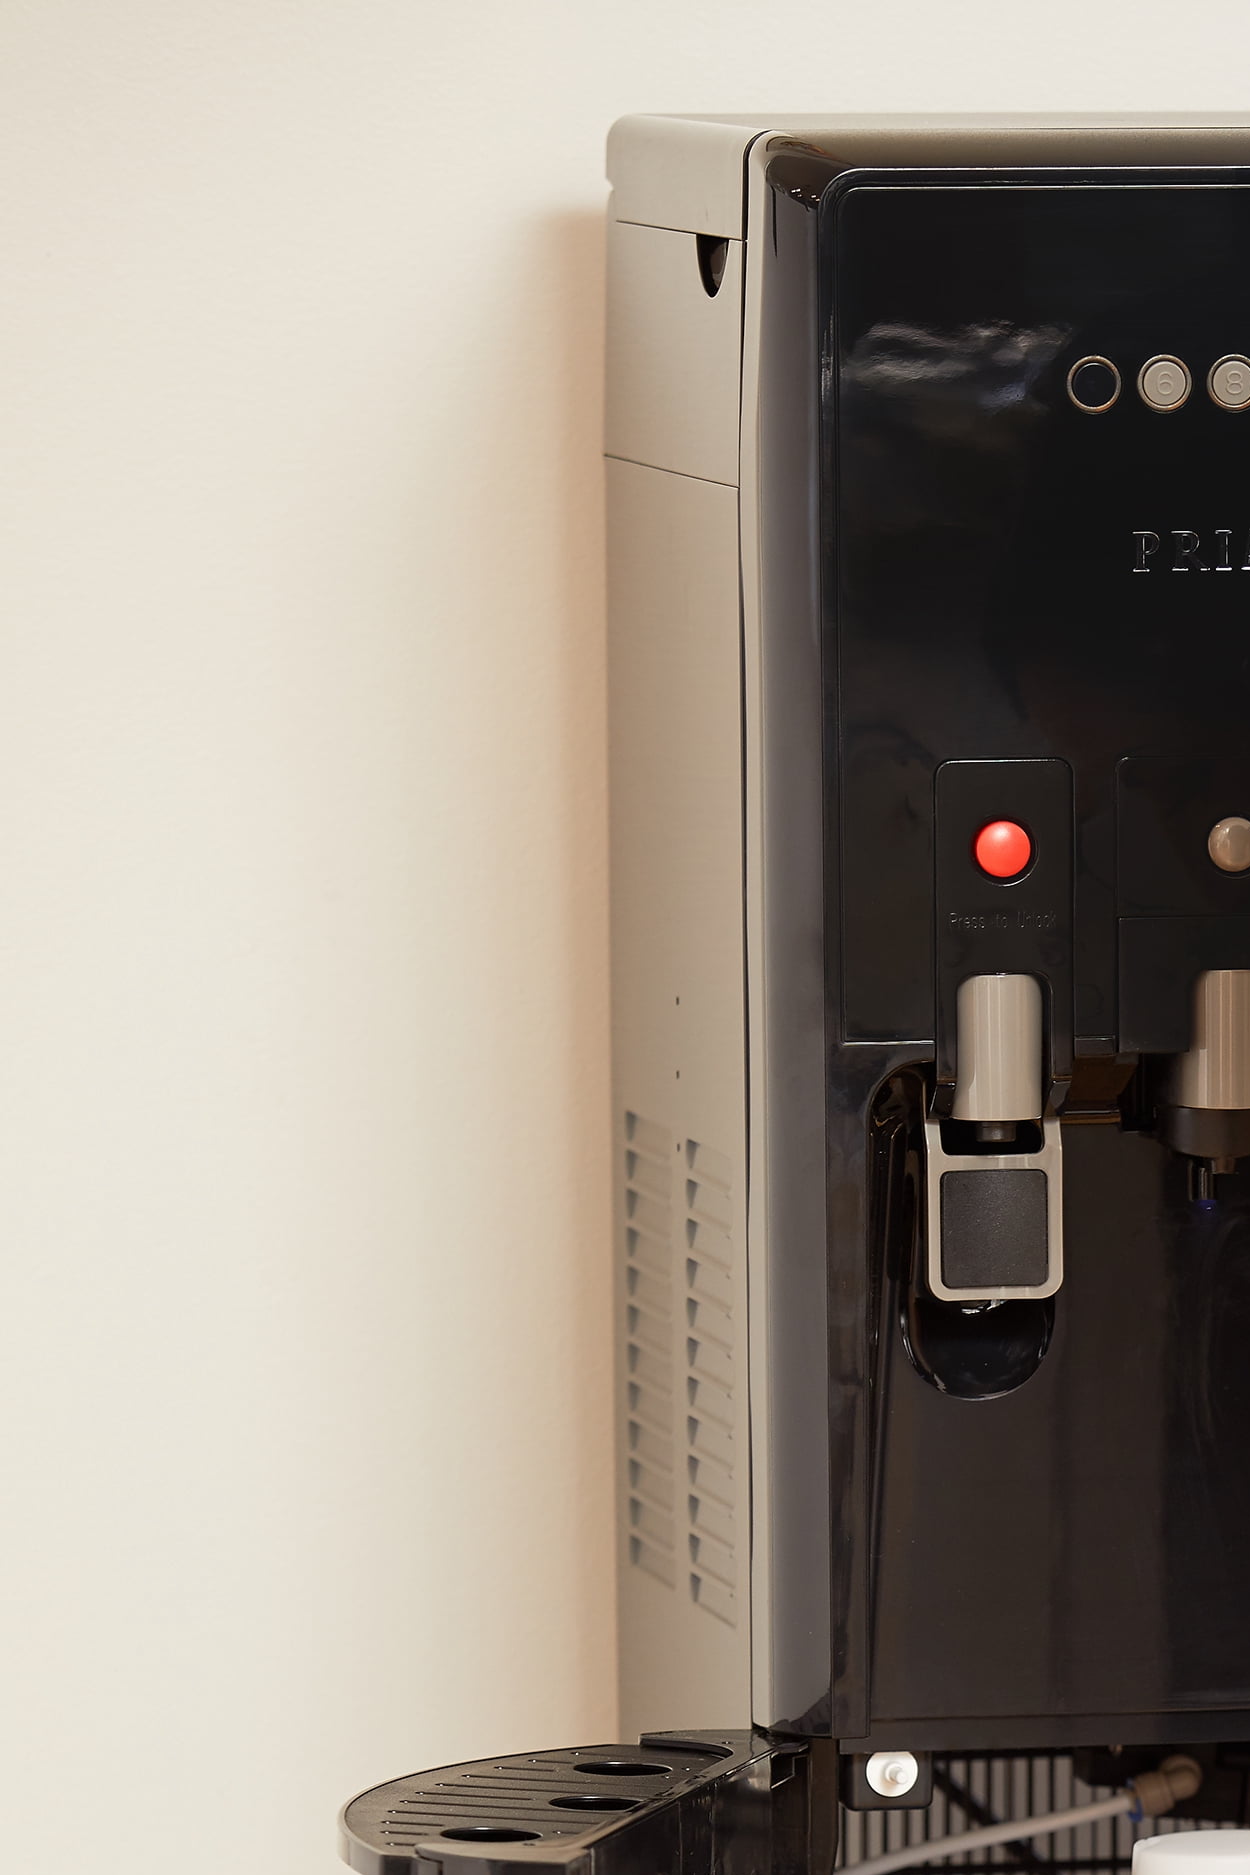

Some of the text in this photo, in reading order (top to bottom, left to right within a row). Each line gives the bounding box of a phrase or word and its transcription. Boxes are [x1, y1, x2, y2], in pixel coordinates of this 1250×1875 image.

[1157, 371, 1174, 396] 6
[1225, 371, 1243, 396] 8
[949, 912, 985, 930] Press
[1016, 909, 1057, 929] Unlock
